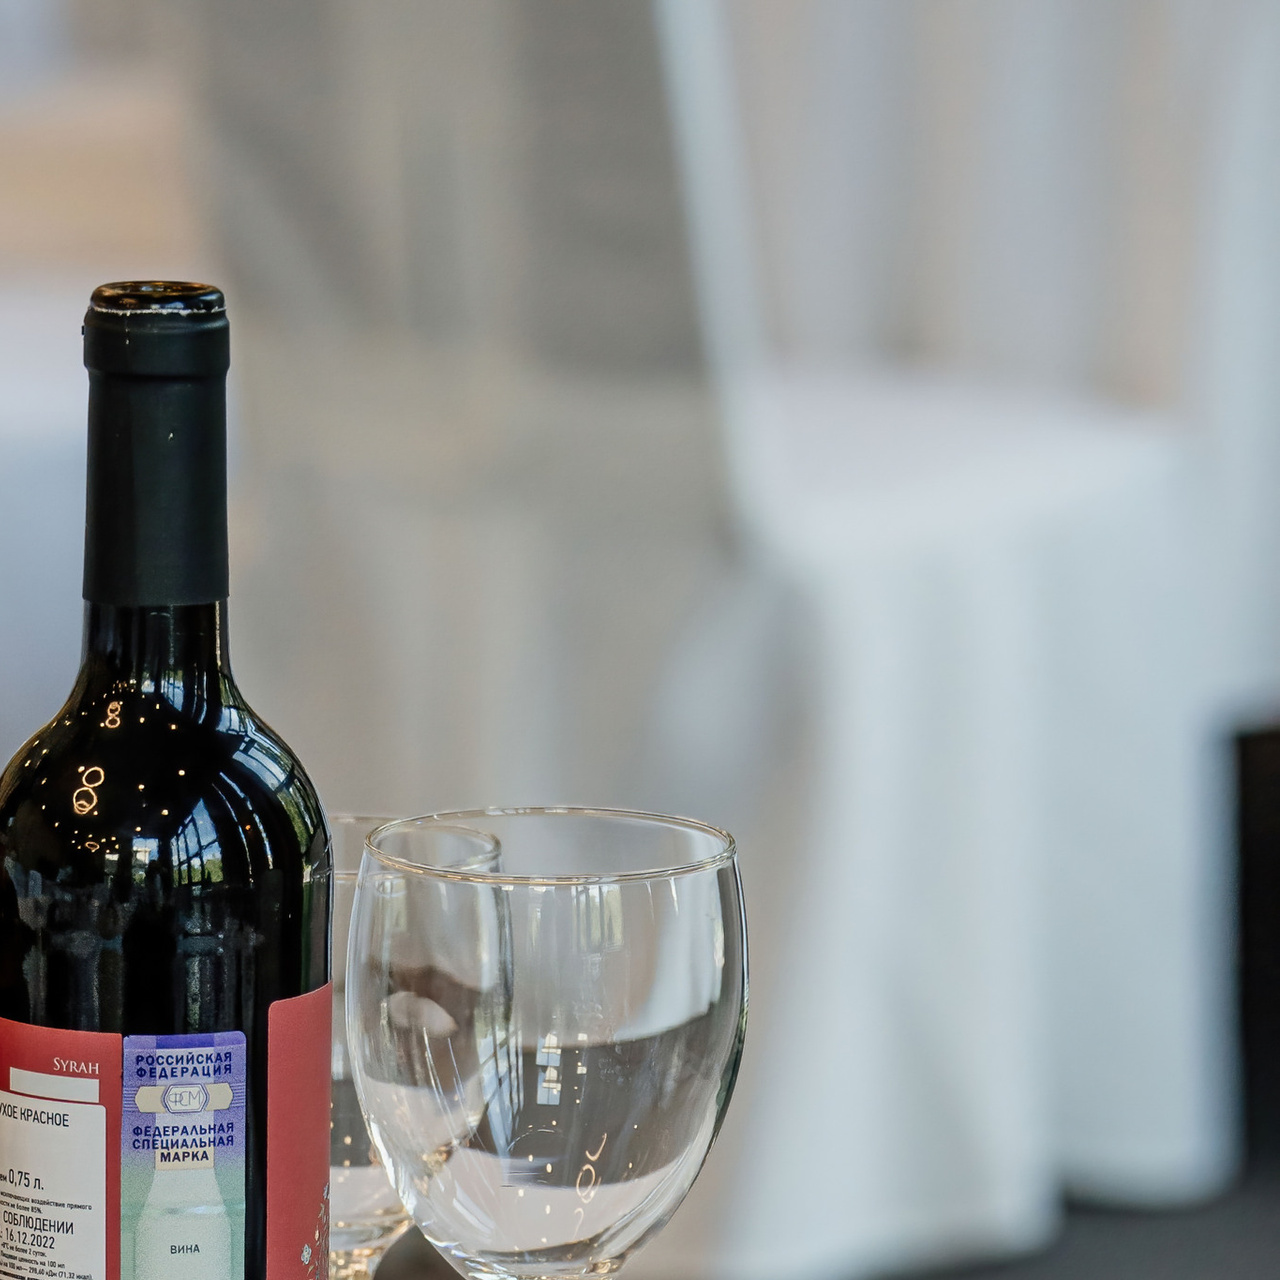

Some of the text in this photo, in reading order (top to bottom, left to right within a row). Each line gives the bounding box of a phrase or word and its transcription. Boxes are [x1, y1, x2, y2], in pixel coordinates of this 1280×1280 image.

[135, 1052, 232, 1066] РОССИЙСКАЯ
[136, 1064, 232, 1080] ФЕДЕРАЦИЯ
[20, 1108, 70, 1127] КРАСНОЕ
[132, 1122, 234, 1138] ФЕДЕРАЛЬНАЯ
[132, 1135, 234, 1151] СПЕЦИАЛЬНАЯ
[160, 1150, 209, 1163] МАРКА
[8, 1168, 30, 1188] 0,75
[33, 1178, 44, 1190] л.
[3, 1210, 74, 1235] СОБЛЮДЕНИИ
[5, 1227, 55, 1249] 16.12.2022
[170, 1244, 200, 1254] ВИНА
